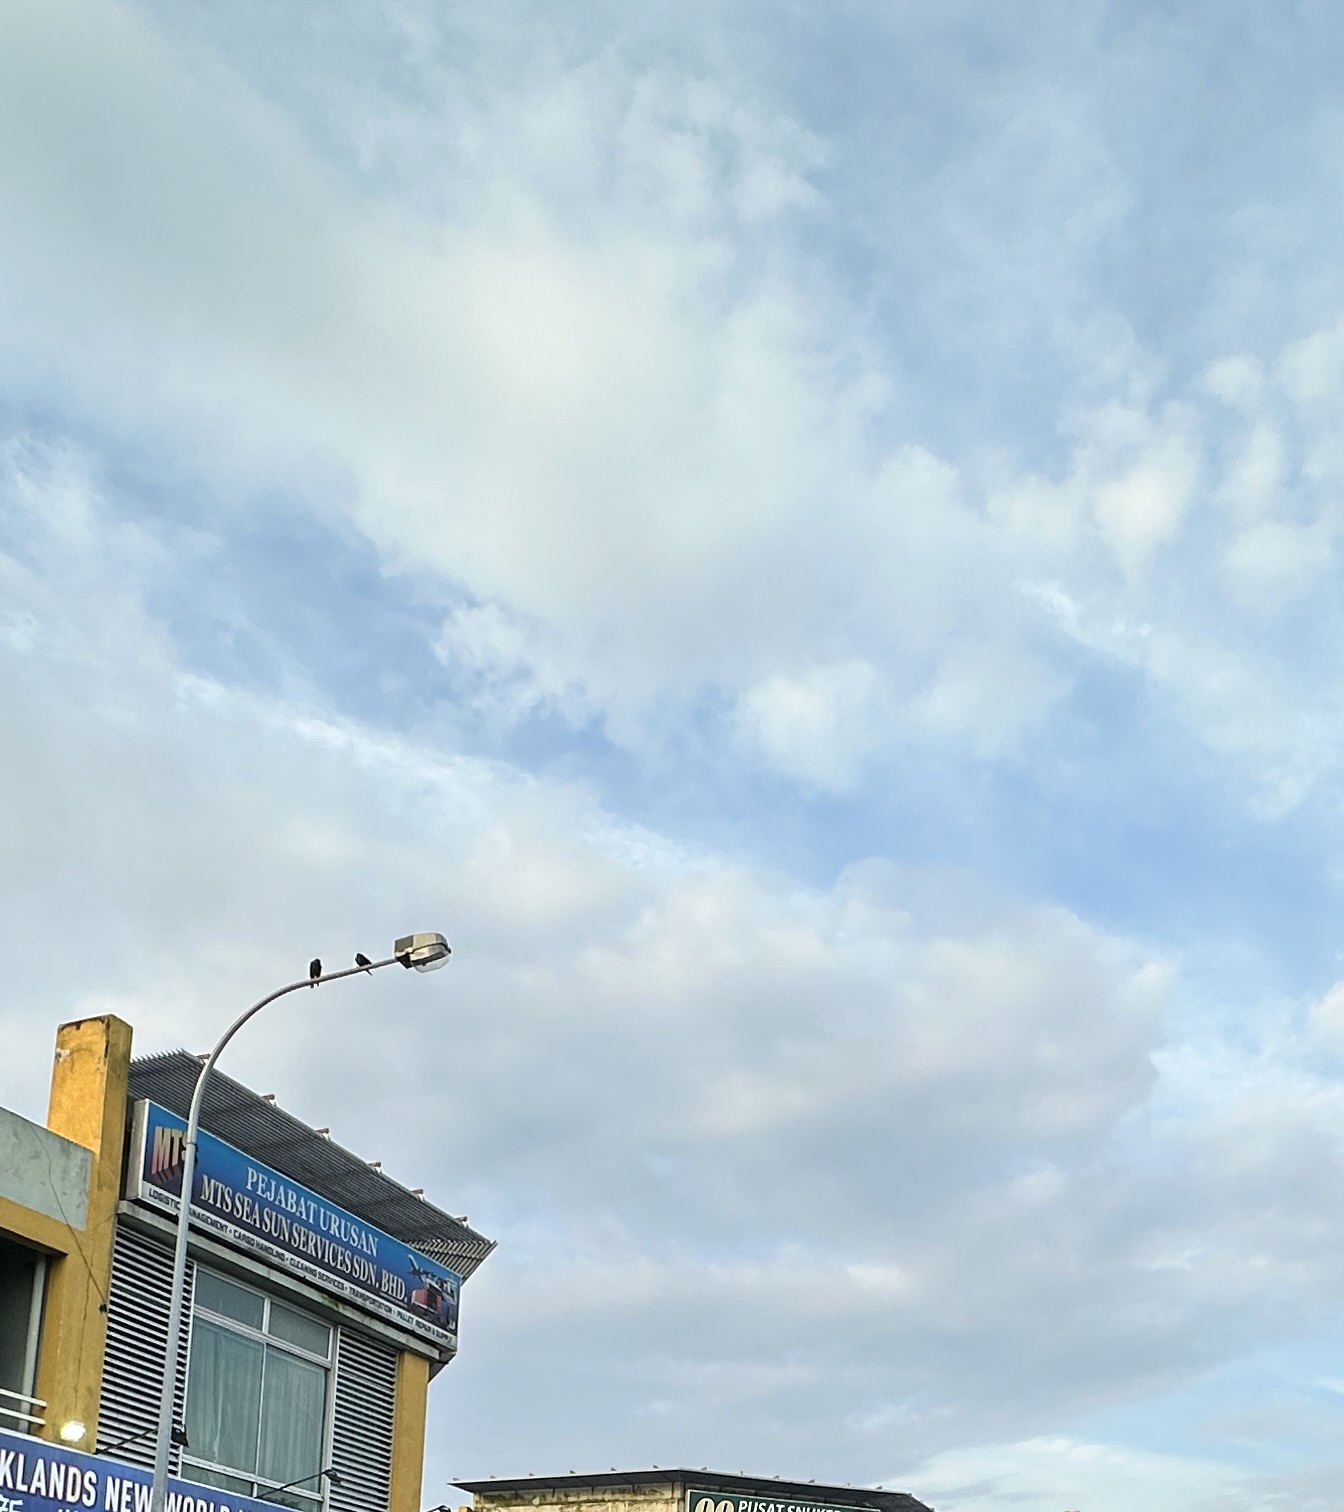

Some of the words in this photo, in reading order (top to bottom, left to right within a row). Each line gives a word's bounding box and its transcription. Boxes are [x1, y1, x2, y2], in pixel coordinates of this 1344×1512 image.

[200, 1174, 233, 1213] MTS
[233, 1191, 261, 1227] SEA
[261, 1206, 291, 1247] SUN
[290, 1221, 352, 1276] SERVICES
[351, 1249, 380, 1290] SDN.
[380, 1268, 408, 1303] BHD.
[246, 1166, 317, 1225] PEJABAT
[318, 1209, 378, 1258] URUSAN
